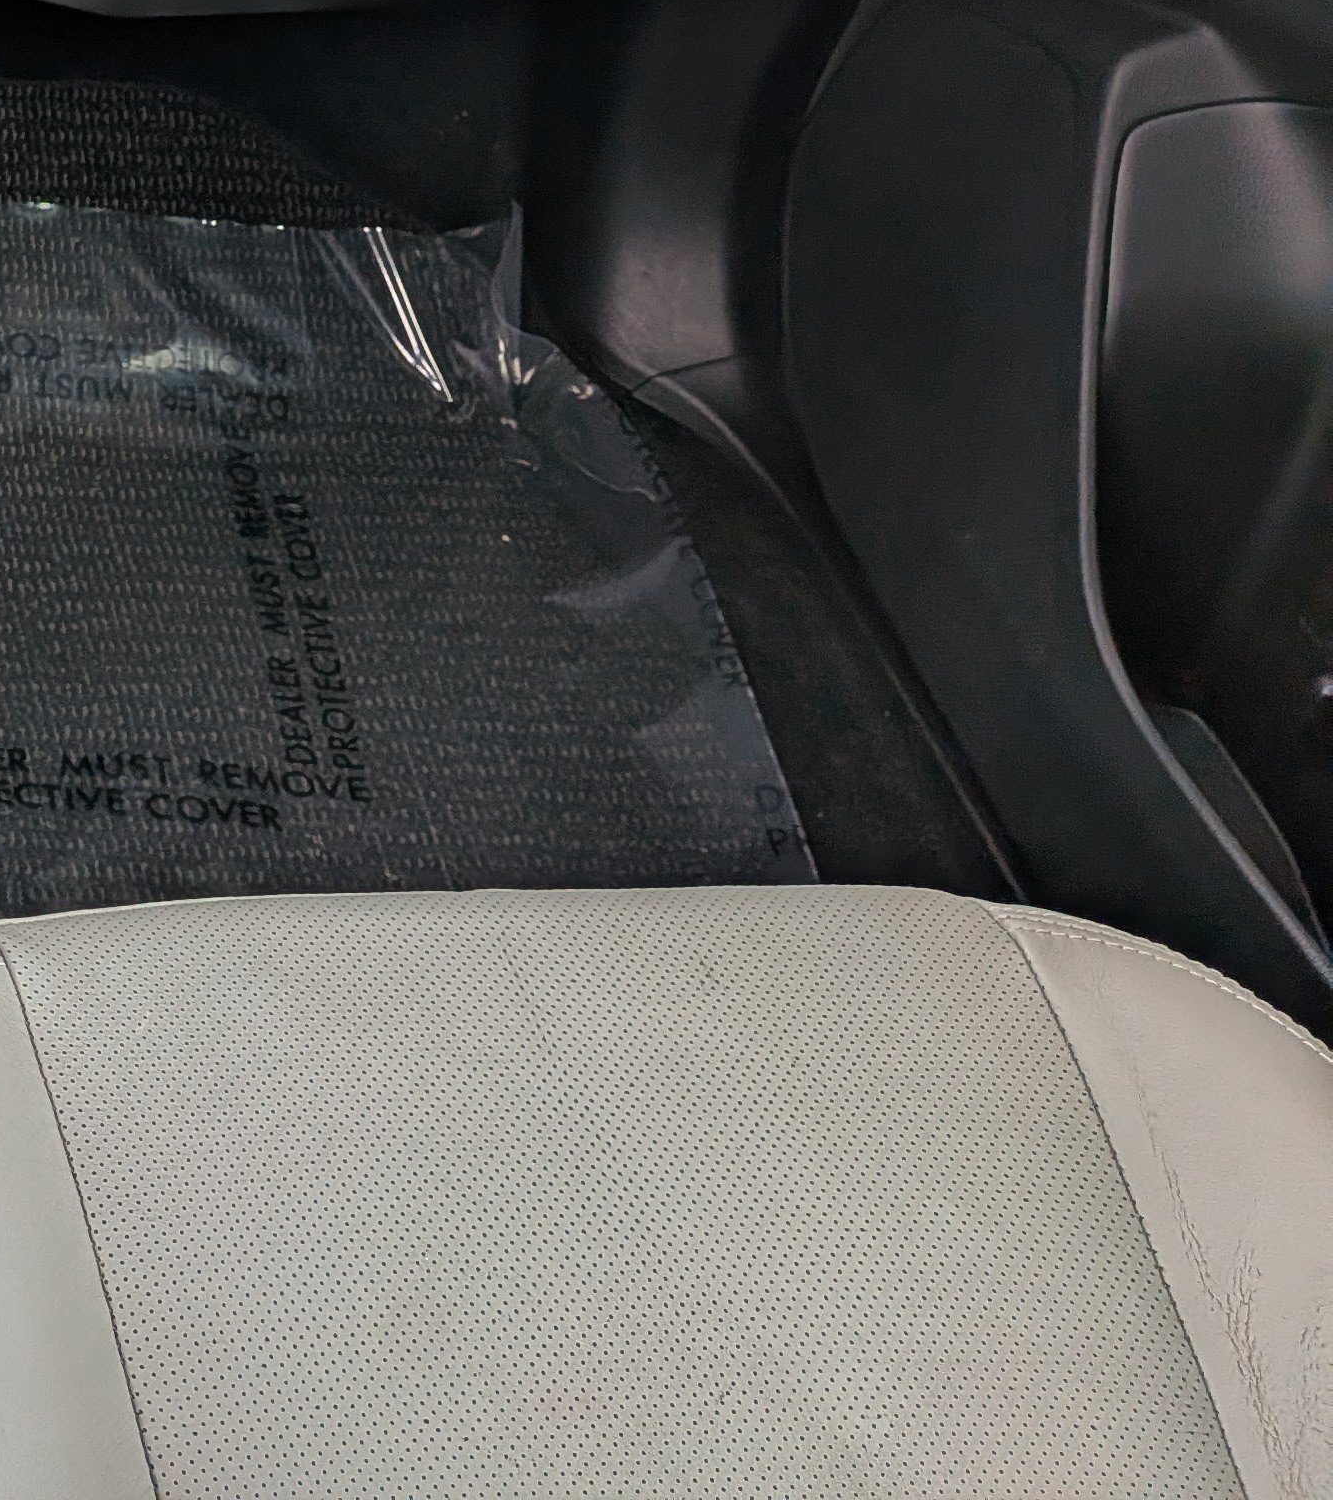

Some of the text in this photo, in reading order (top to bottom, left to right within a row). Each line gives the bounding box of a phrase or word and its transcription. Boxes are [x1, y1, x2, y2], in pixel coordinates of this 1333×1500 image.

[245, 553, 293, 637] MUST
[266, 654, 318, 766] DEALER
[295, 593, 366, 770] PROTECTIVE
[59, 752, 173, 788] MUST
[199, 757, 373, 804] REMOVE
[143, 793, 283, 833] COVER
